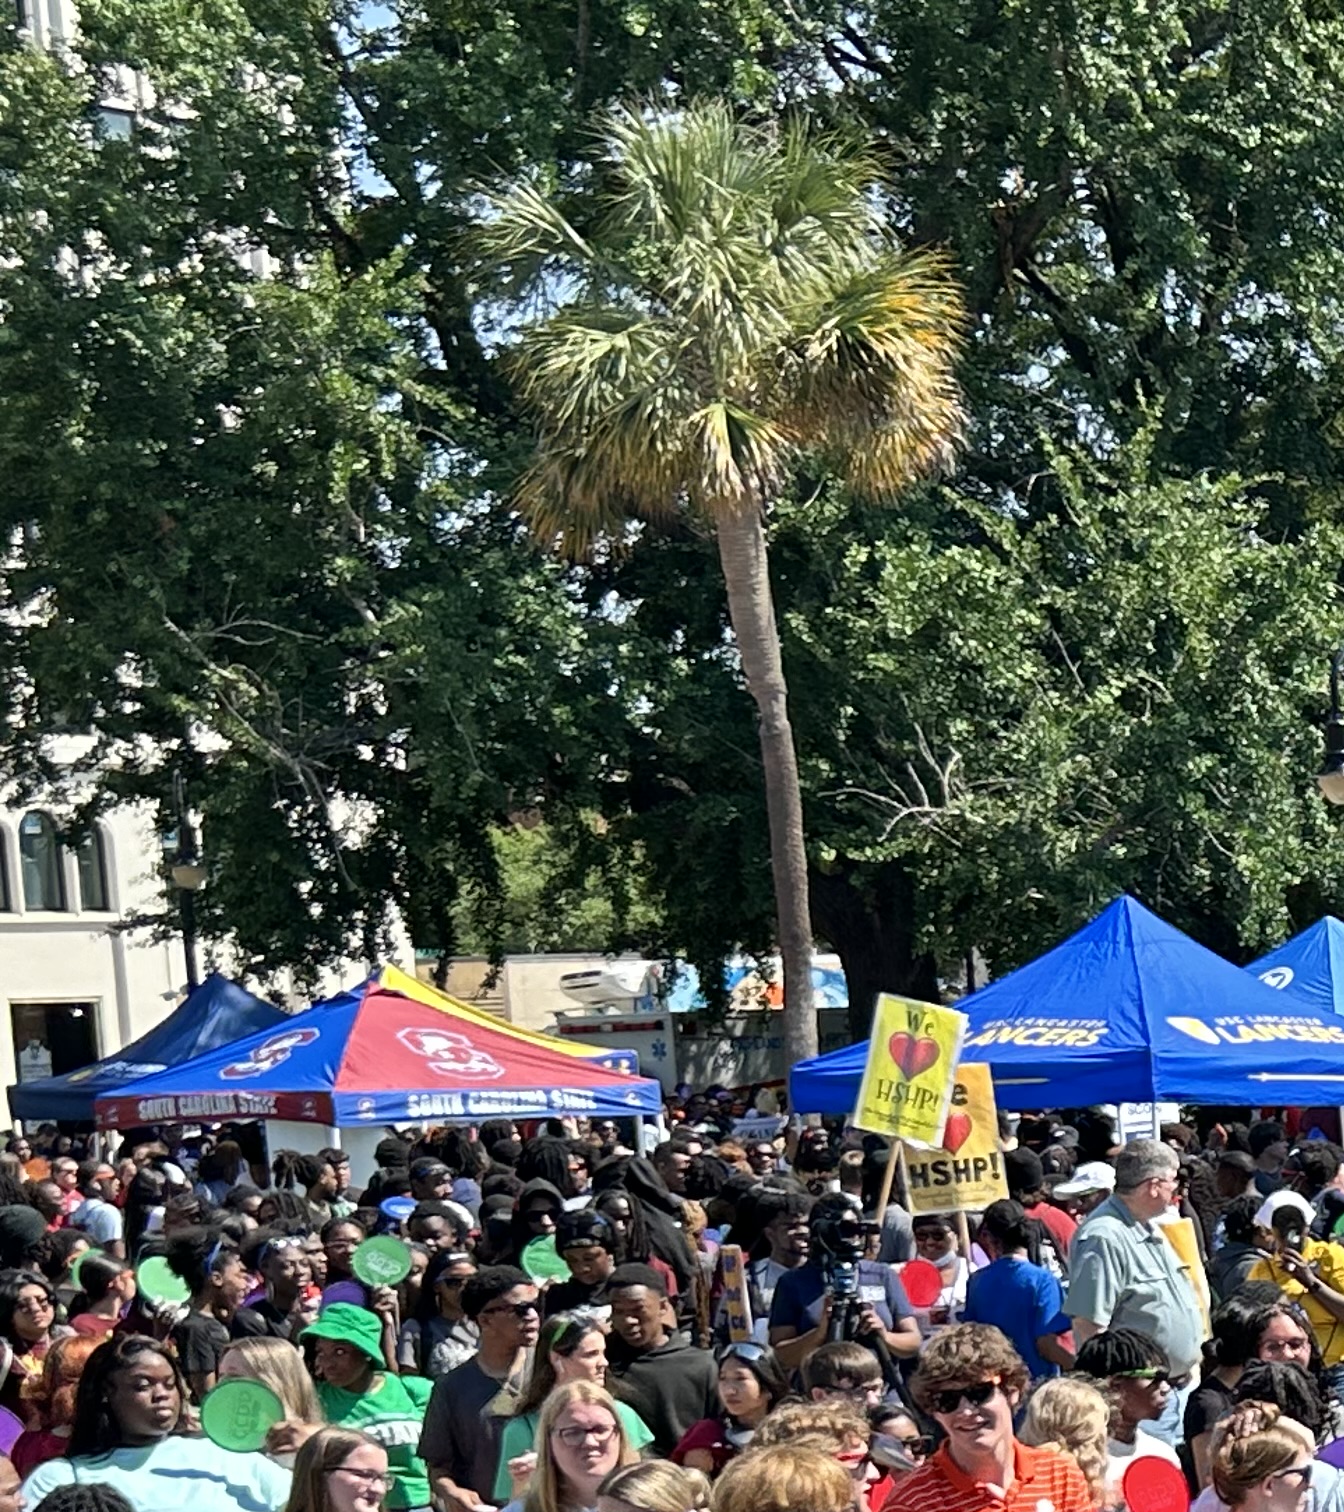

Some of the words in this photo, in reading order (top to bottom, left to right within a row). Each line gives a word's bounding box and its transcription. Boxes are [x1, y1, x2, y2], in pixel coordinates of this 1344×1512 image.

[906, 1010, 934, 1036] We
[407, 1092, 465, 1117] SOUTH
[877, 1079, 940, 1111] HSHP!
[951, 1083, 969, 1106] e
[137, 1098, 176, 1121] SOUTH
[909, 1152, 1001, 1190] HSHP!
